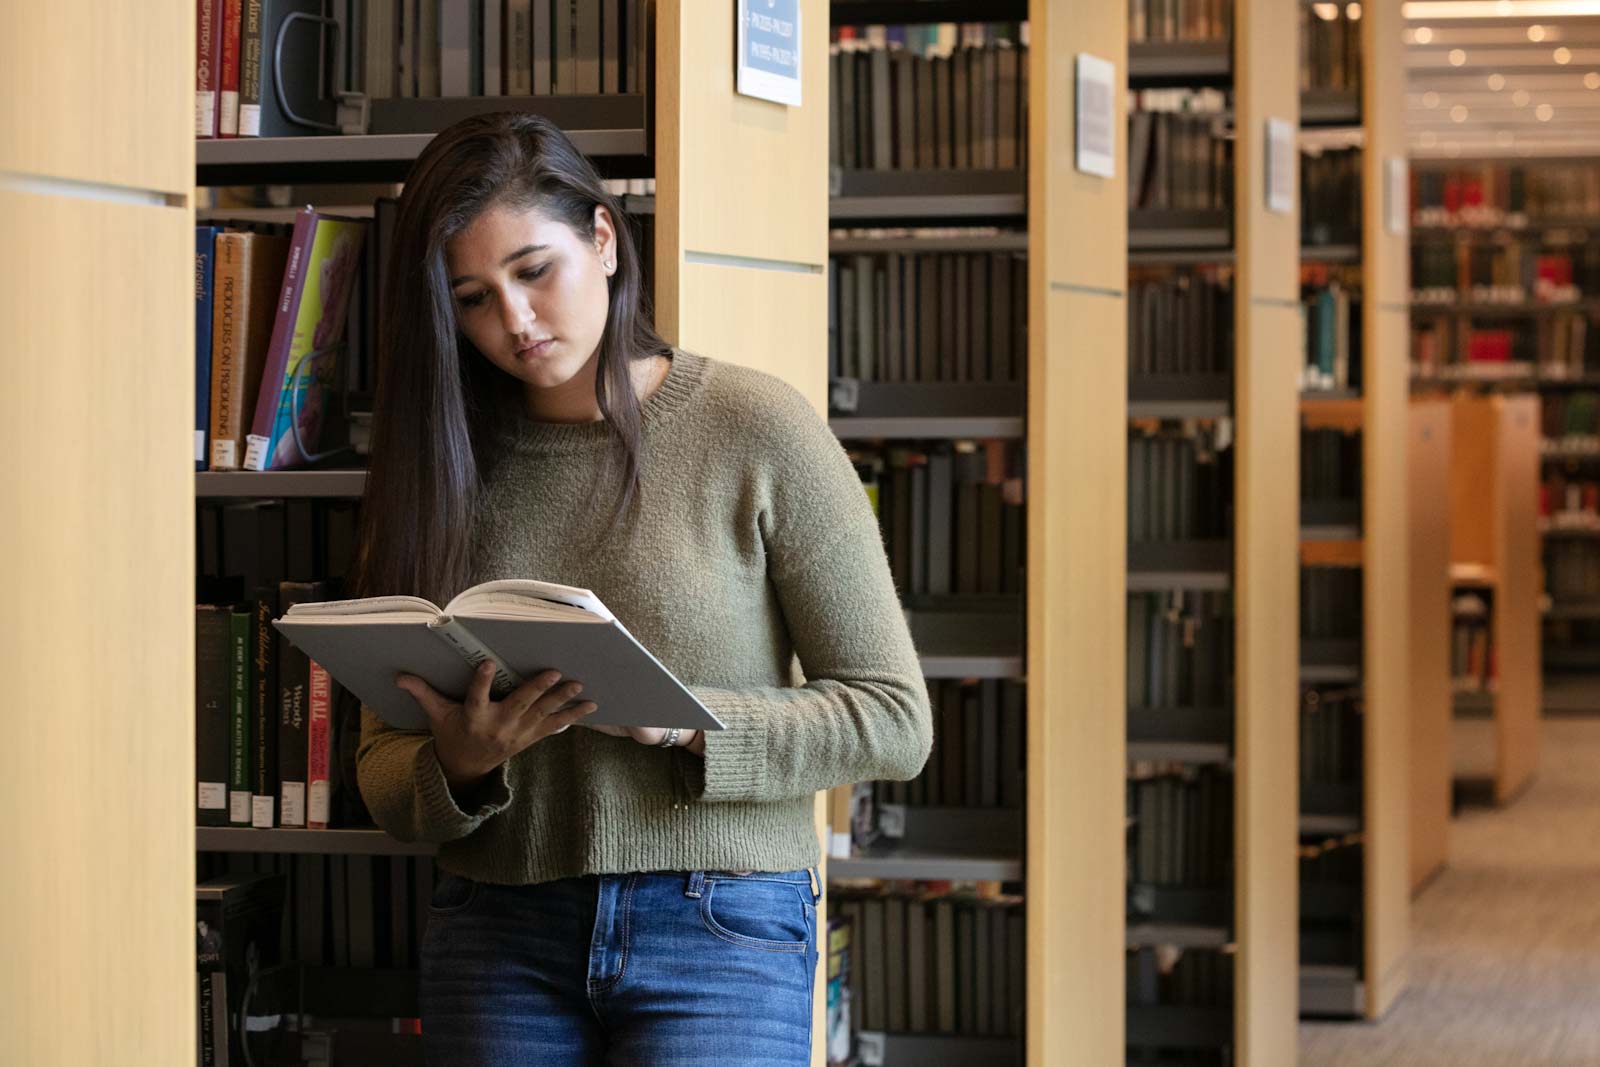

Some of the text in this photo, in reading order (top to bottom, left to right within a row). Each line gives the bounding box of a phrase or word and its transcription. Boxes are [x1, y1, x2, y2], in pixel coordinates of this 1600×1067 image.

[223, 276, 233, 344] PRODUCERS
[222, 346, 232, 365] ON
[219, 368, 231, 436] PRODUCING
[282, 687, 292, 725] Allen
[292, 684, 303, 729] Woody
[313, 669, 328, 722] TAKE ALL
